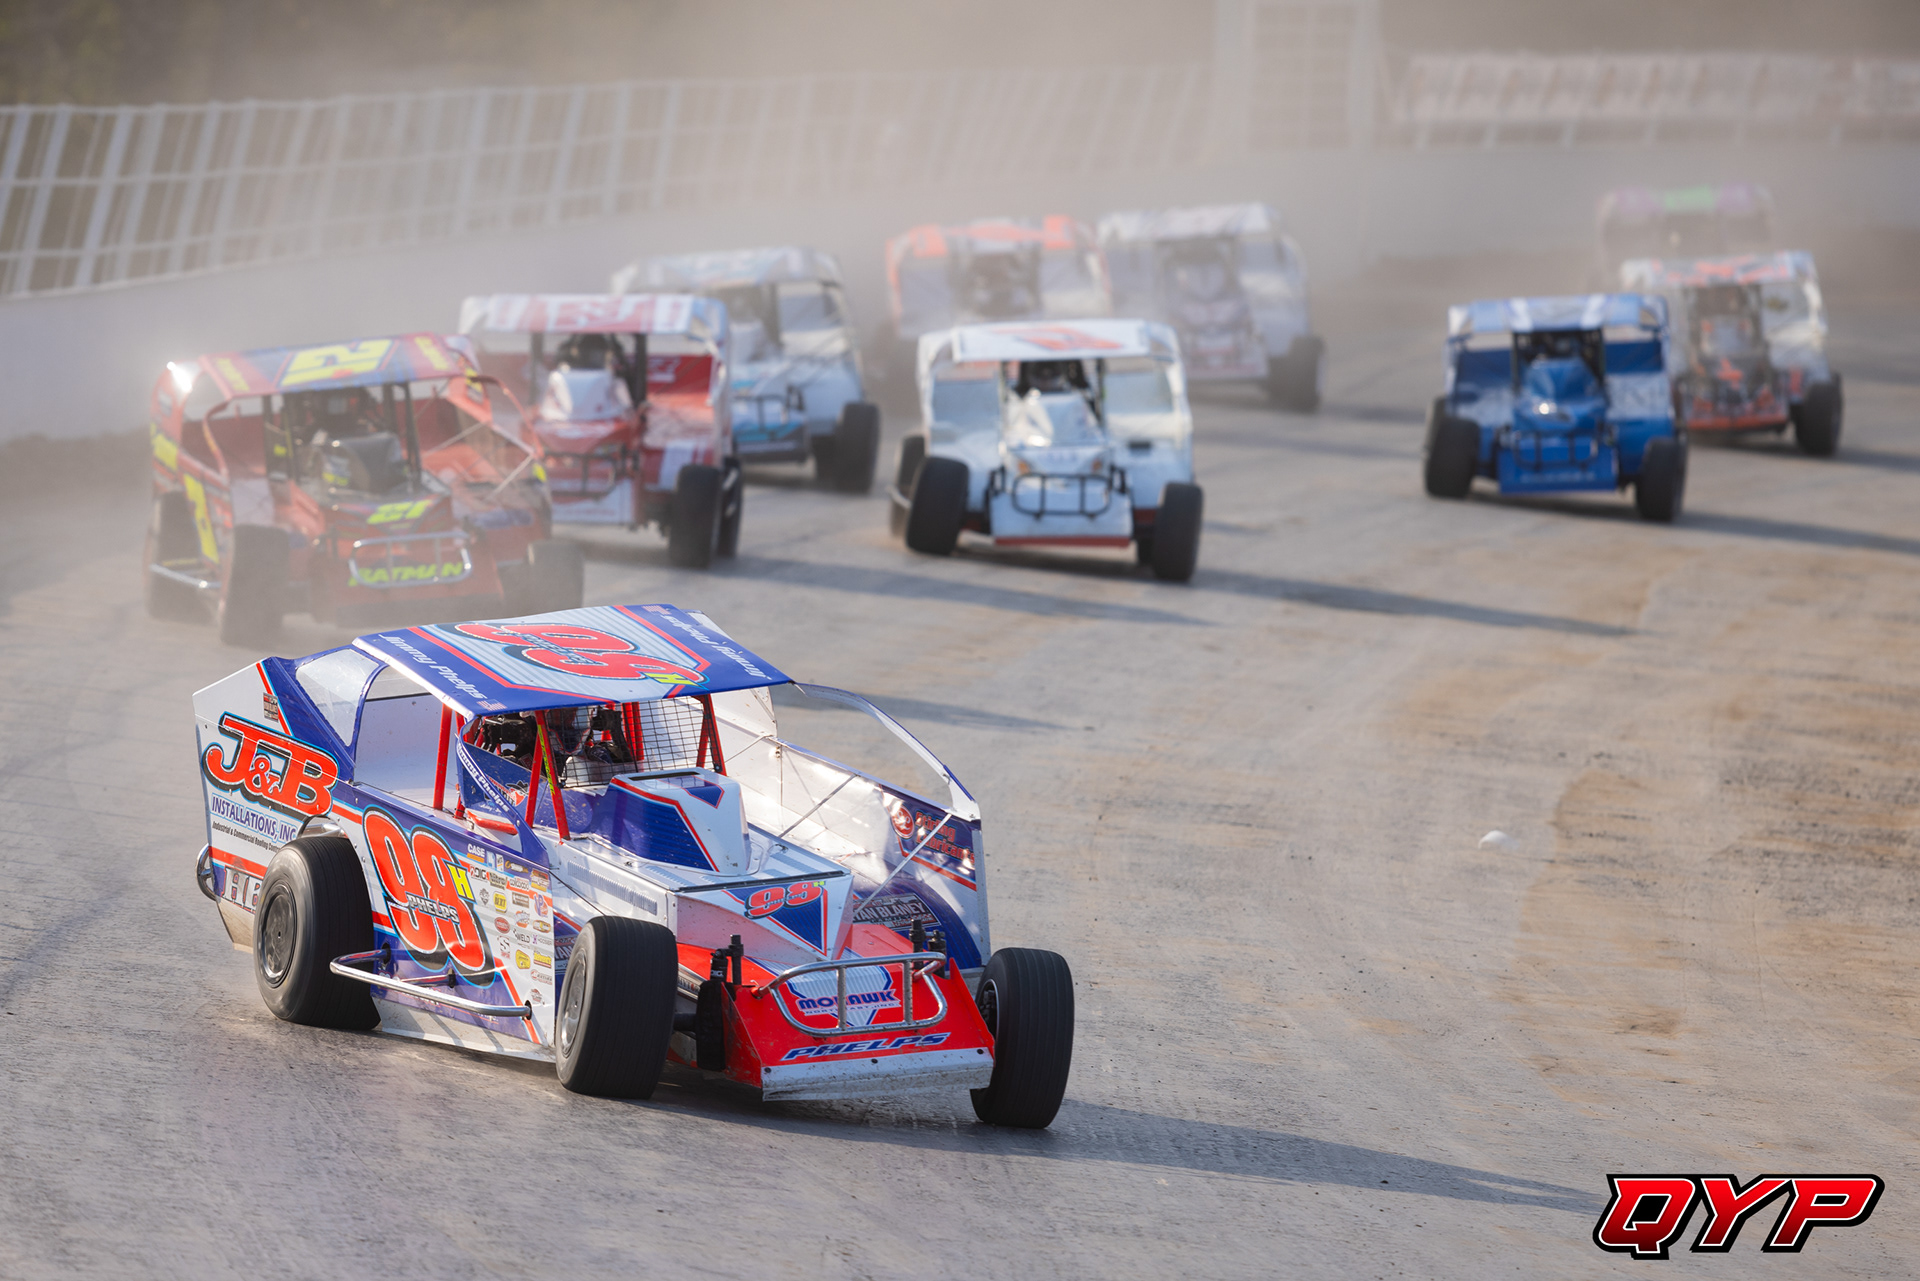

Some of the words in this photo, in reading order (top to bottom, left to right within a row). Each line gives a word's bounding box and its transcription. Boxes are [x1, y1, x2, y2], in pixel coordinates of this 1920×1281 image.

[378, 633, 437, 664] Jimmy
[429, 665, 488, 699] Phelps
[203, 713, 338, 820] J&B
[479, 775, 510, 812] Phelps
[212, 796, 278, 840] INSTALLATIONS,
[467, 843, 486, 858] CASE
[407, 893, 460, 924] PHELPS
[877, 902, 926, 918] BLANEY
[780, 1032, 951, 1061] PHELPS
